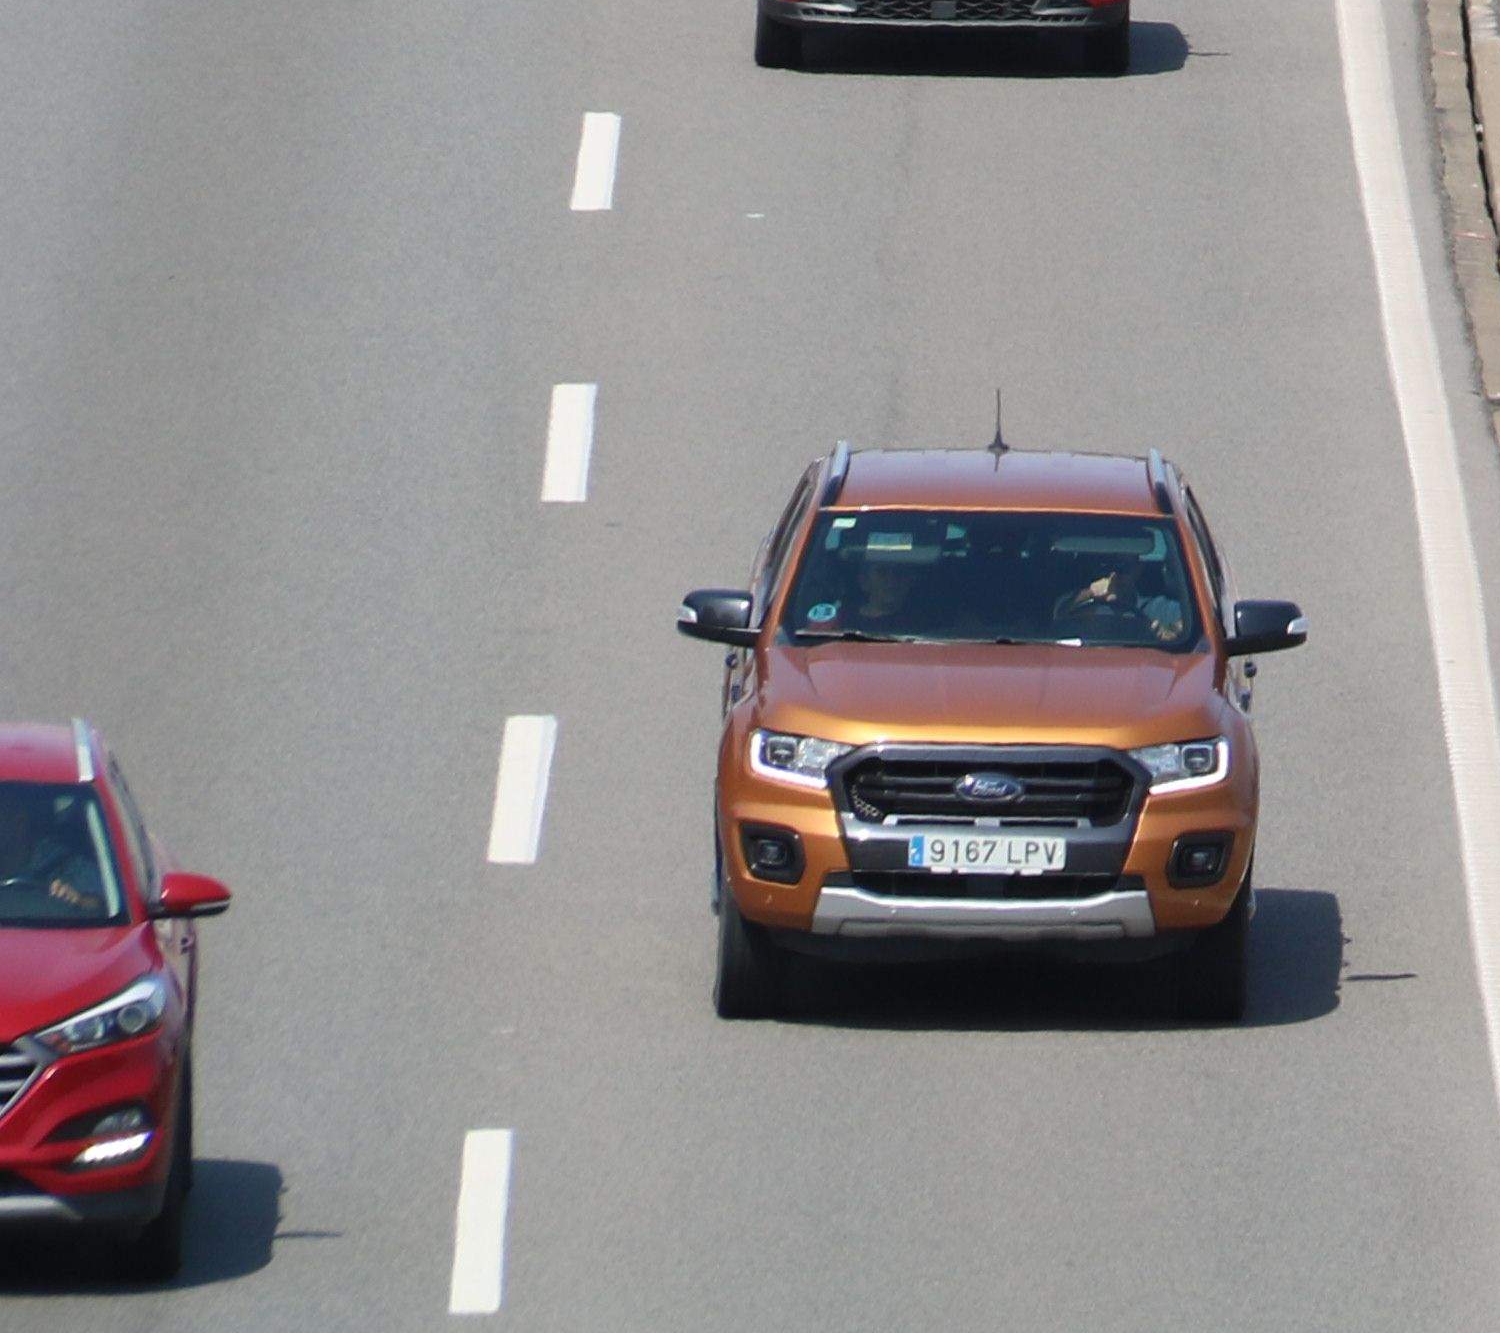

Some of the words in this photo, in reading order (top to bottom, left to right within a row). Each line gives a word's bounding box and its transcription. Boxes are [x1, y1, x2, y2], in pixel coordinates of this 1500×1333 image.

[971, 778, 1010, 798] Ford
[930, 840, 997, 865] 9167
[1007, 841, 1060, 868] LPV
